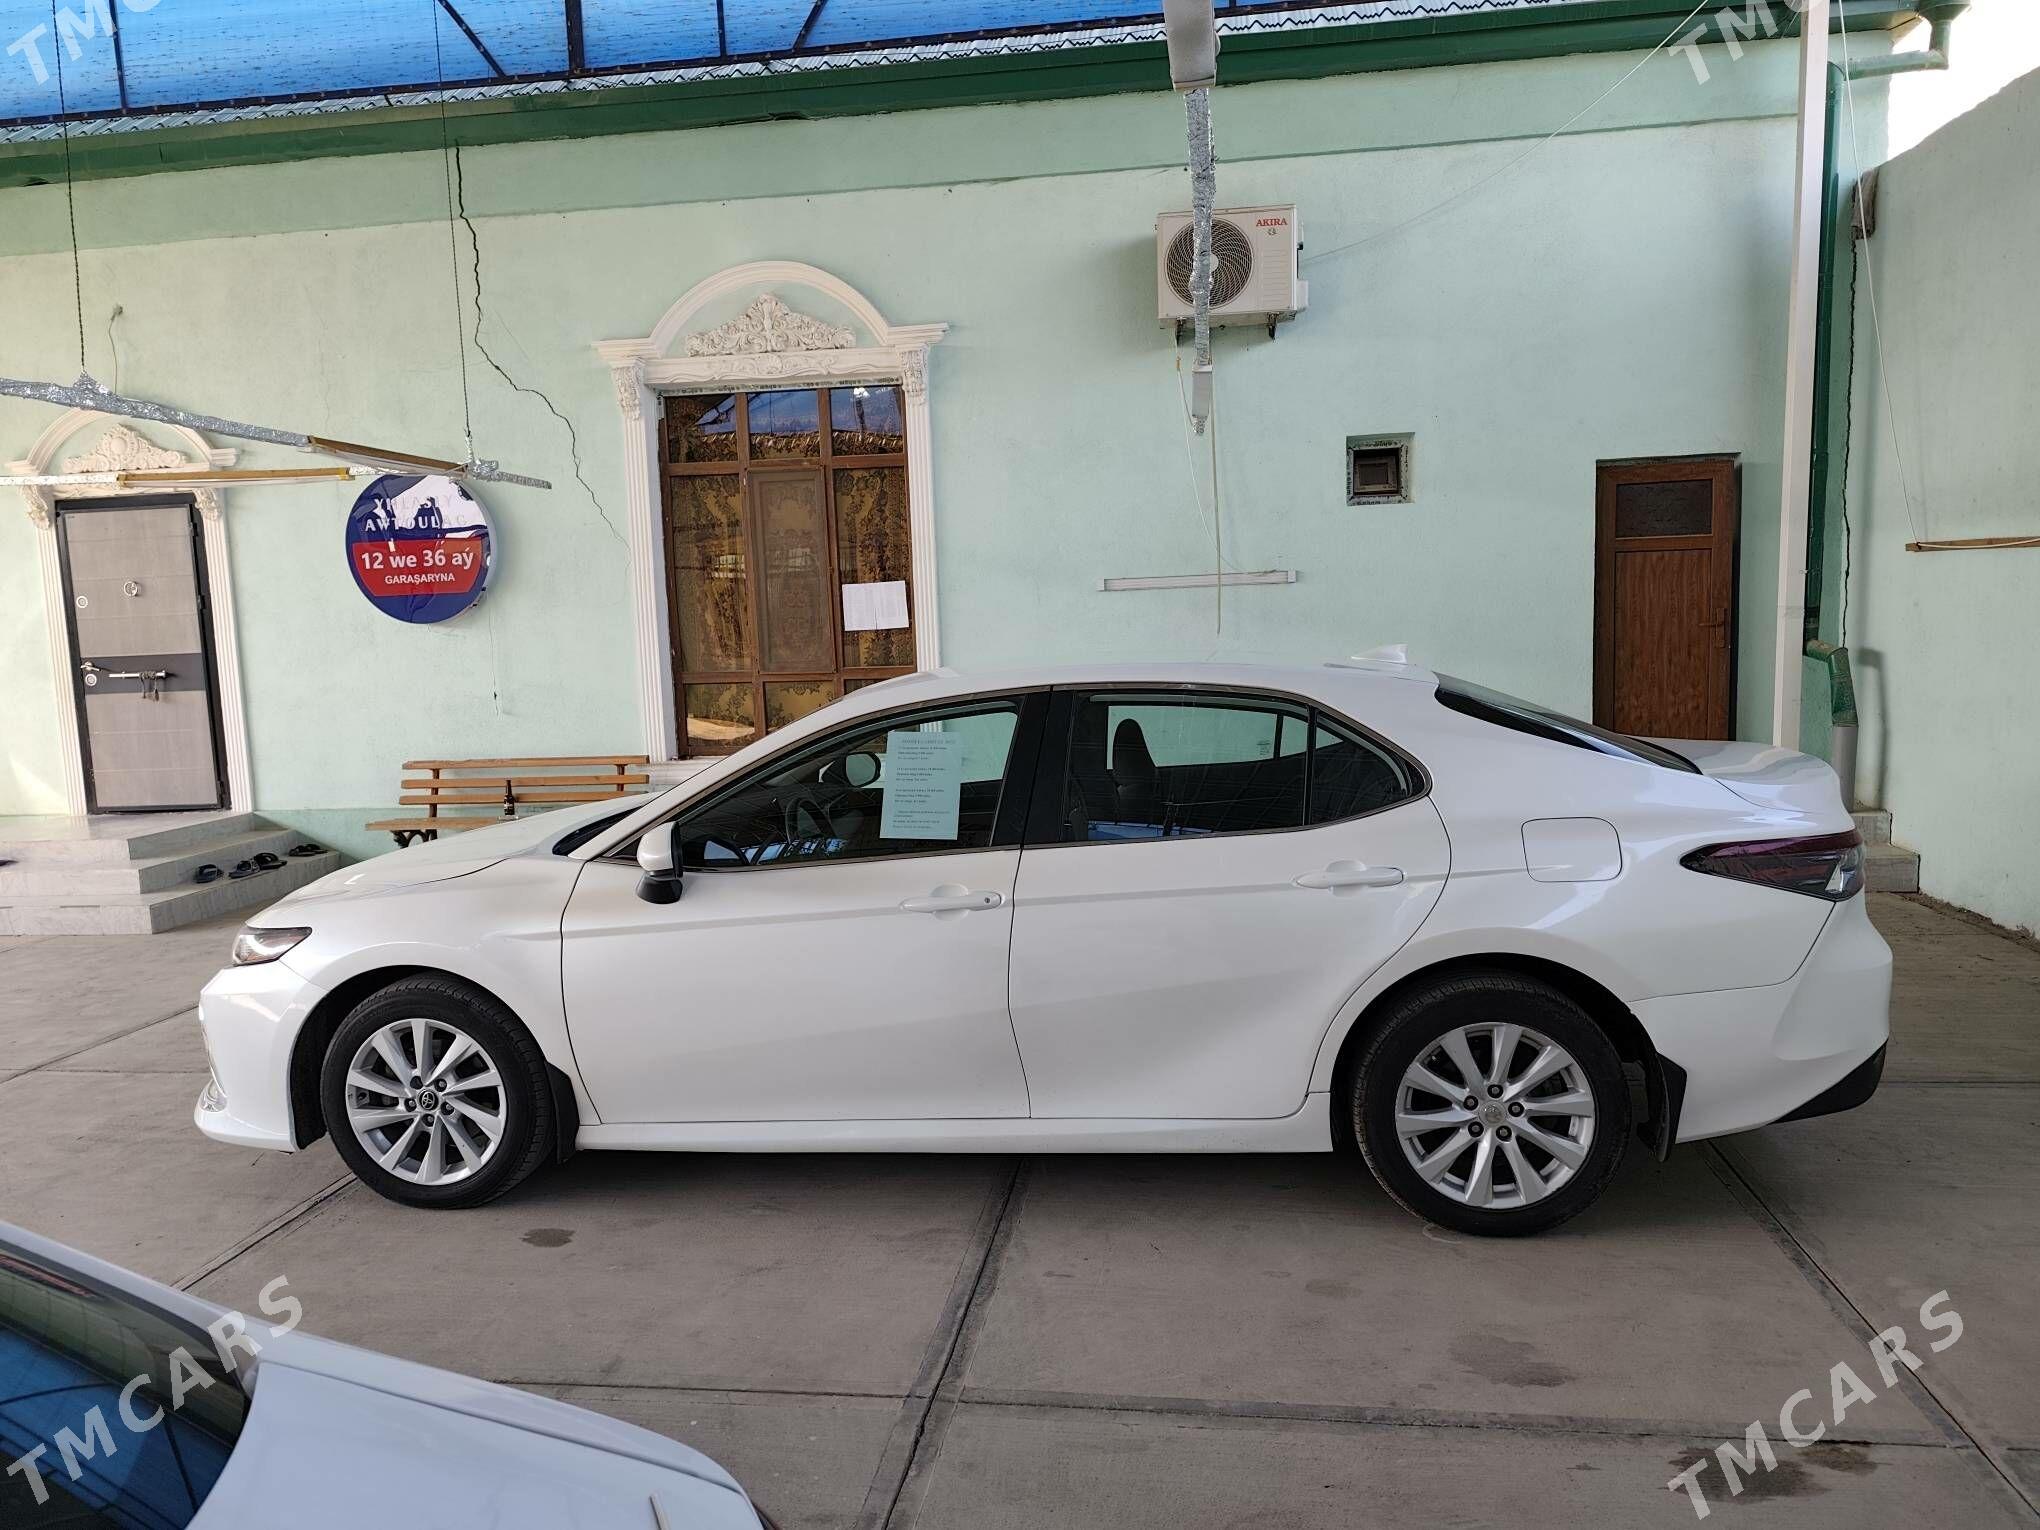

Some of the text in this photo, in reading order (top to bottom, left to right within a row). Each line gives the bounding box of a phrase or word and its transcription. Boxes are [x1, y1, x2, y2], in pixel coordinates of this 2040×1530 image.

[1256, 218, 1288, 227] AKIRA
[362, 548, 474, 570] 12 we 36 aý
[384, 573, 456, 585] GARAŞARYNA
